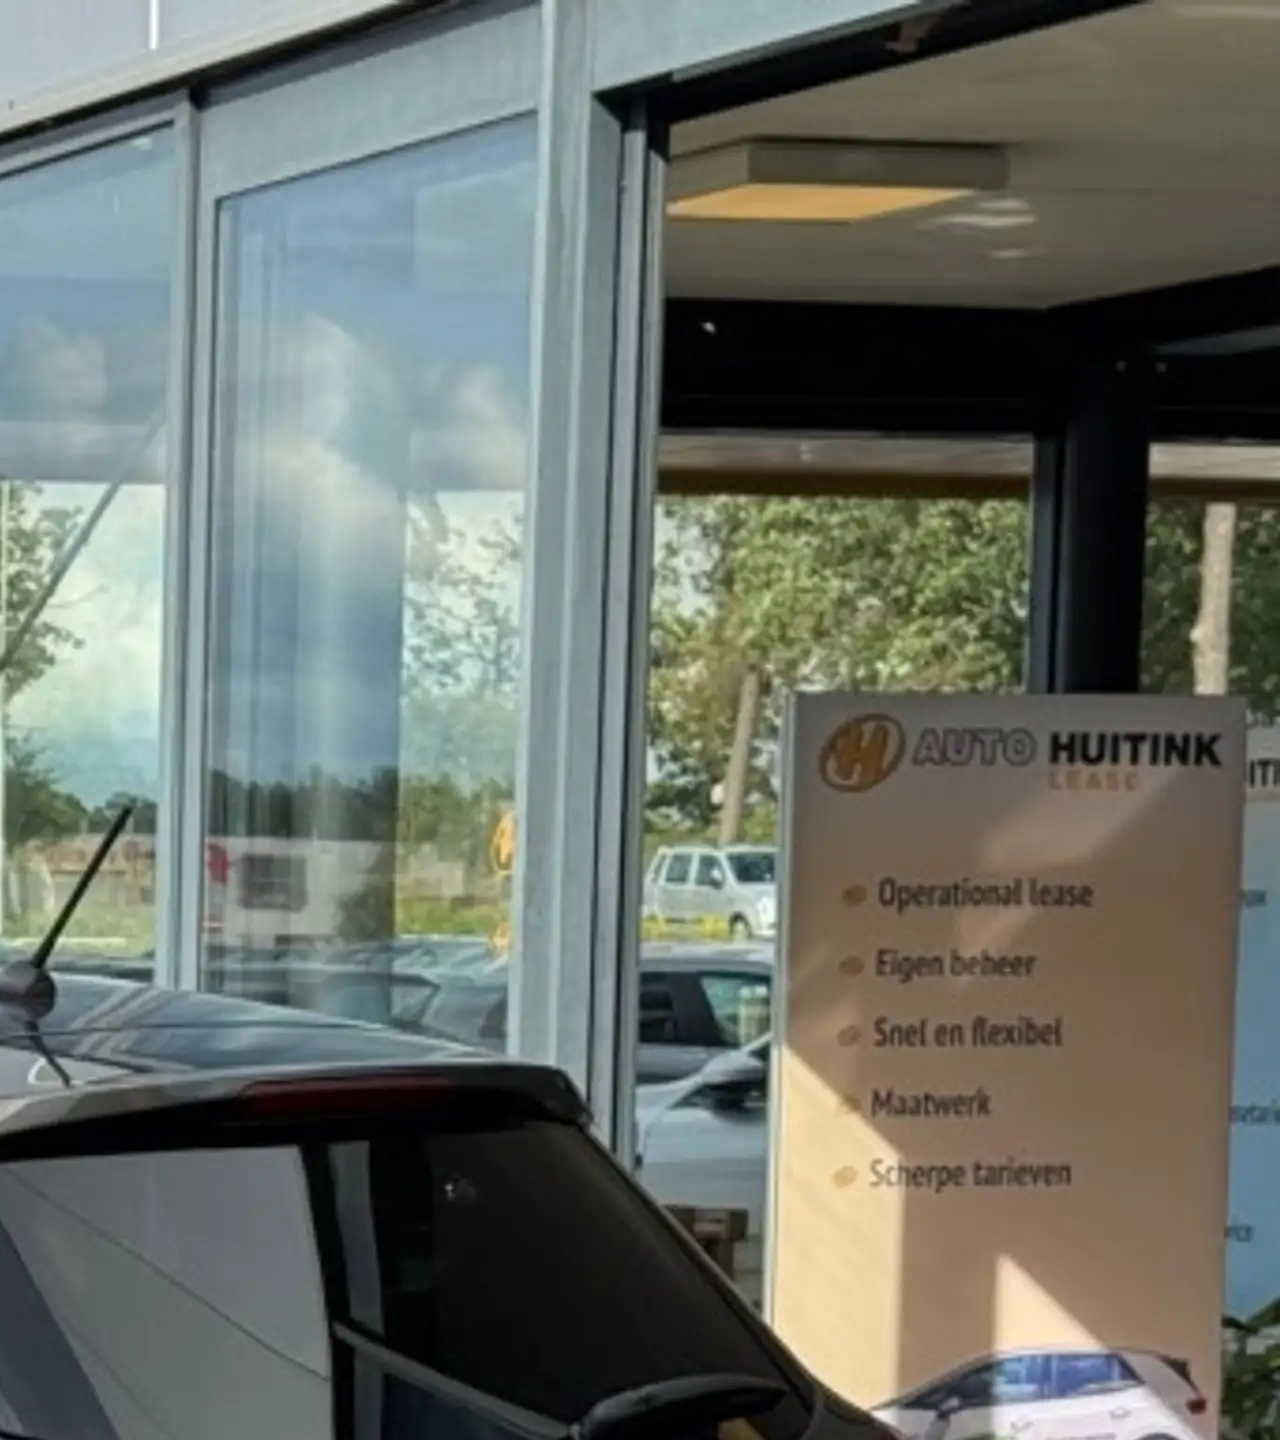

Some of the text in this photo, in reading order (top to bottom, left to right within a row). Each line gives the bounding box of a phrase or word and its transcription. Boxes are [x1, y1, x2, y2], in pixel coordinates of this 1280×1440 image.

[910, 727, 1037, 767] AUTO
[1048, 731, 1224, 767] HUITINK
[1048, 770, 1138, 791] LEASE
[878, 876, 1095, 915] Operational lease
[874, 949, 1037, 983] Eigen beheer
[873, 1014, 1064, 1048] Snel en flexibel
[870, 1087, 992, 1118] Maatwerk
[870, 1154, 1073, 1194] Scherpe tarieven
